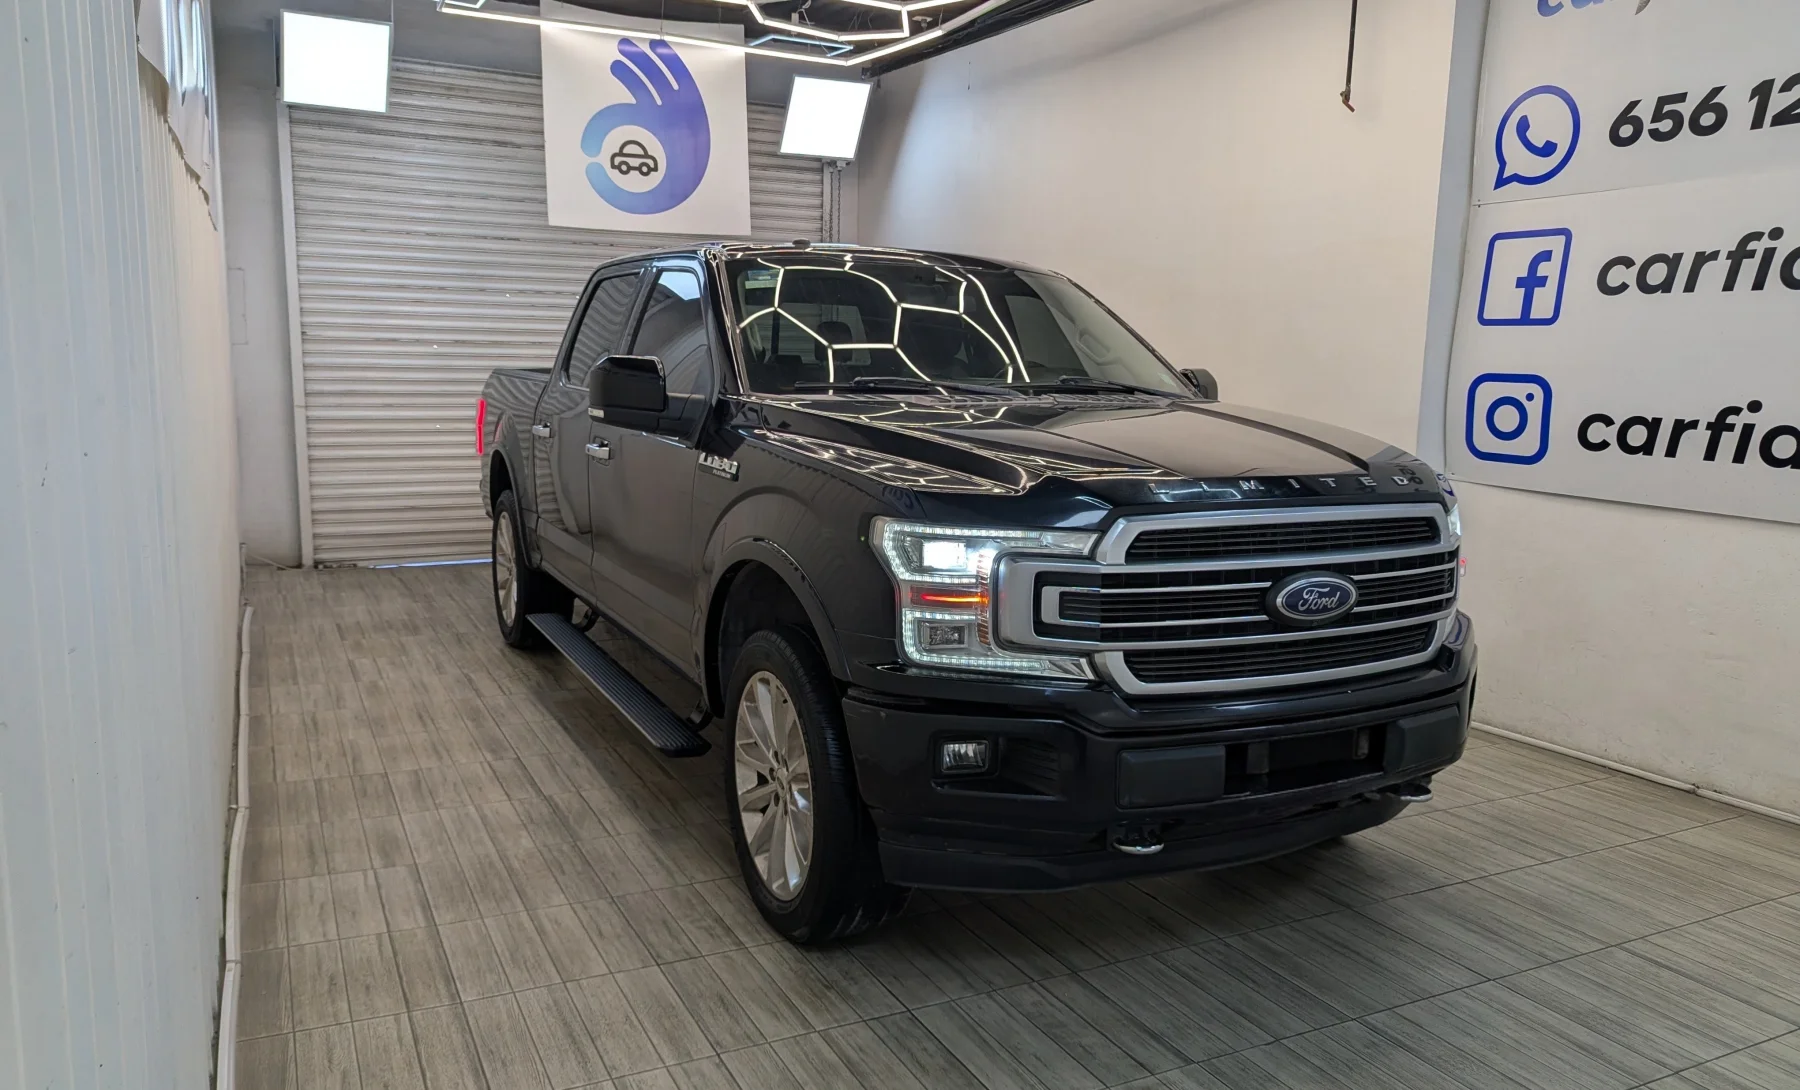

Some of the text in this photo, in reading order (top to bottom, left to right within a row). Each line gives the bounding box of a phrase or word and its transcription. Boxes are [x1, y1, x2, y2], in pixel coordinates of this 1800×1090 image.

[1608, 72, 1800, 148] 656 12
[1149, 475, 1411, 495] LIMITED
[1298, 586, 1341, 611] Ford
